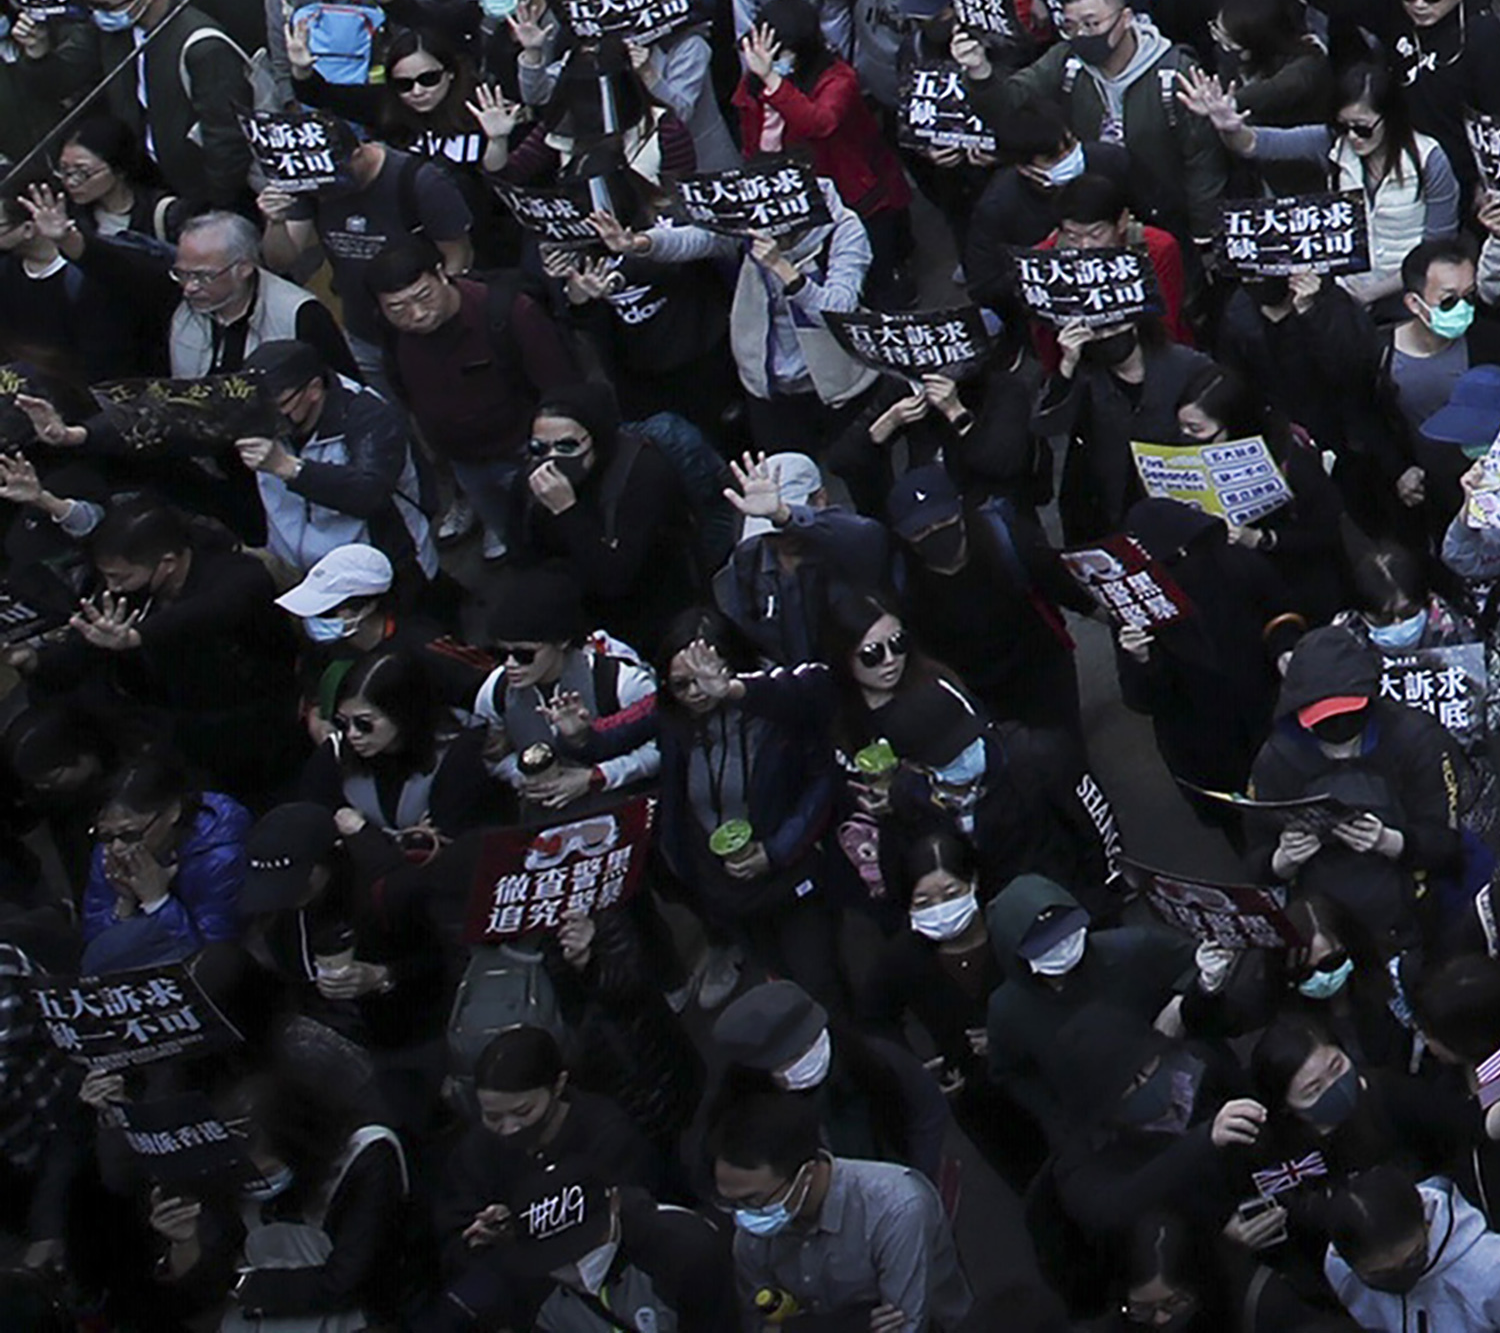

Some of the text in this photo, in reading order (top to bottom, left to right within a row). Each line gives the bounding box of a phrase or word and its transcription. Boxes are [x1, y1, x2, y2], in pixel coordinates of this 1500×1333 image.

[679, 169, 807, 212] 五大訴求
[686, 194, 813, 231] 缺一不可
[1222, 201, 1354, 236] 五大訴求
[1224, 225, 1357, 260] 缺一不可
[1016, 252, 1144, 286] 五大訴求
[1021, 276, 1148, 311] 缺一不可
[846, 316, 969, 345] 五大訴求
[36, 977, 185, 1021] 五大訴求
[52, 1001, 204, 1052] 缺一不可
